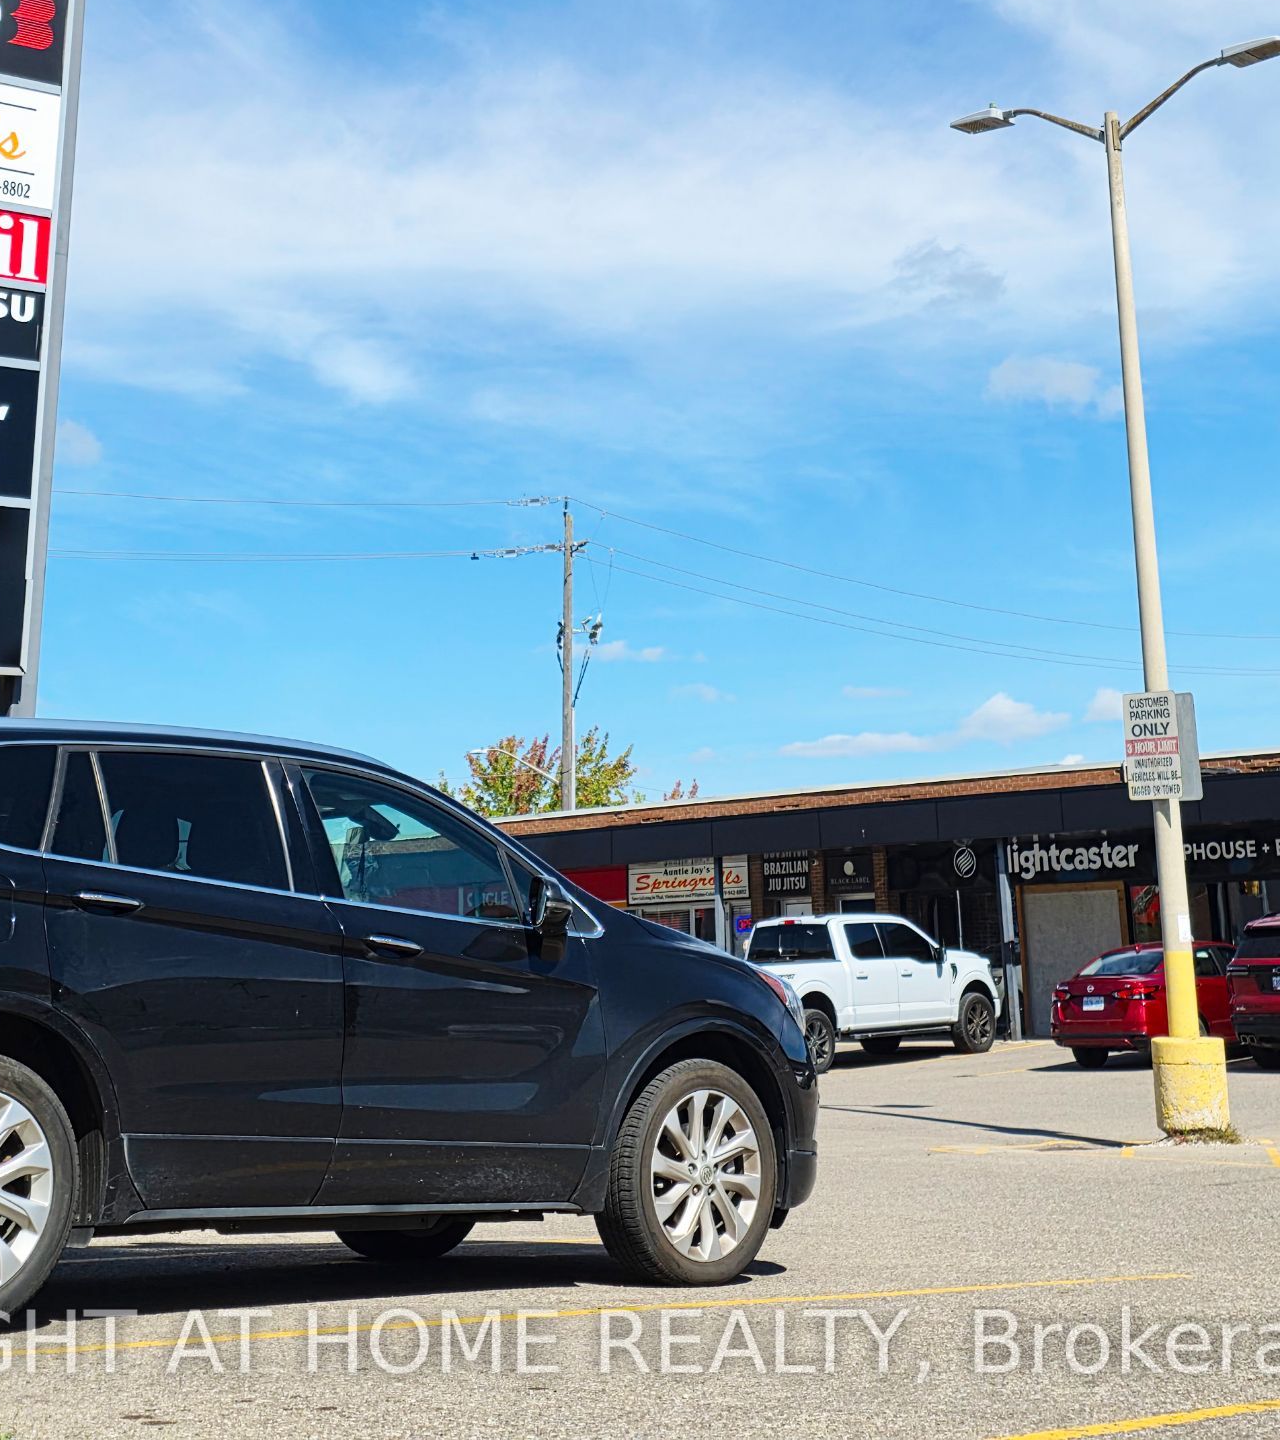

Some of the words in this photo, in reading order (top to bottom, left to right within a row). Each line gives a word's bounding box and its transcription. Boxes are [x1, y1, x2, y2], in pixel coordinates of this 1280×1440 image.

[1129, 696, 1169, 710] CUSTOMER
[1130, 708, 1170, 721] PARKING
[1131, 722, 1170, 737] ONLY
[1134, 741, 1156, 754] HOUR
[1157, 740, 1177, 754] LIMIT
[1134, 757, 1173, 769] UNAUTHORIZED
[1131, 771, 1155, 782] VEHICLES
[1157, 771, 1170, 780] WILL
[1171, 770, 1179, 780] BE
[1131, 785, 1151, 797] TAGGED
[1162, 784, 1181, 795] TOWED
[1184, 840, 1257, 861] PHOUSE
[1007, 840, 1139, 880] lightcaster
[663, 867, 689, 876] Auntie
[691, 866, 710, 876] Joy's
[763, 860, 809, 875] BRAZILIAN
[768, 878, 782, 891] JIU
[783, 876, 806, 890] JITSU
